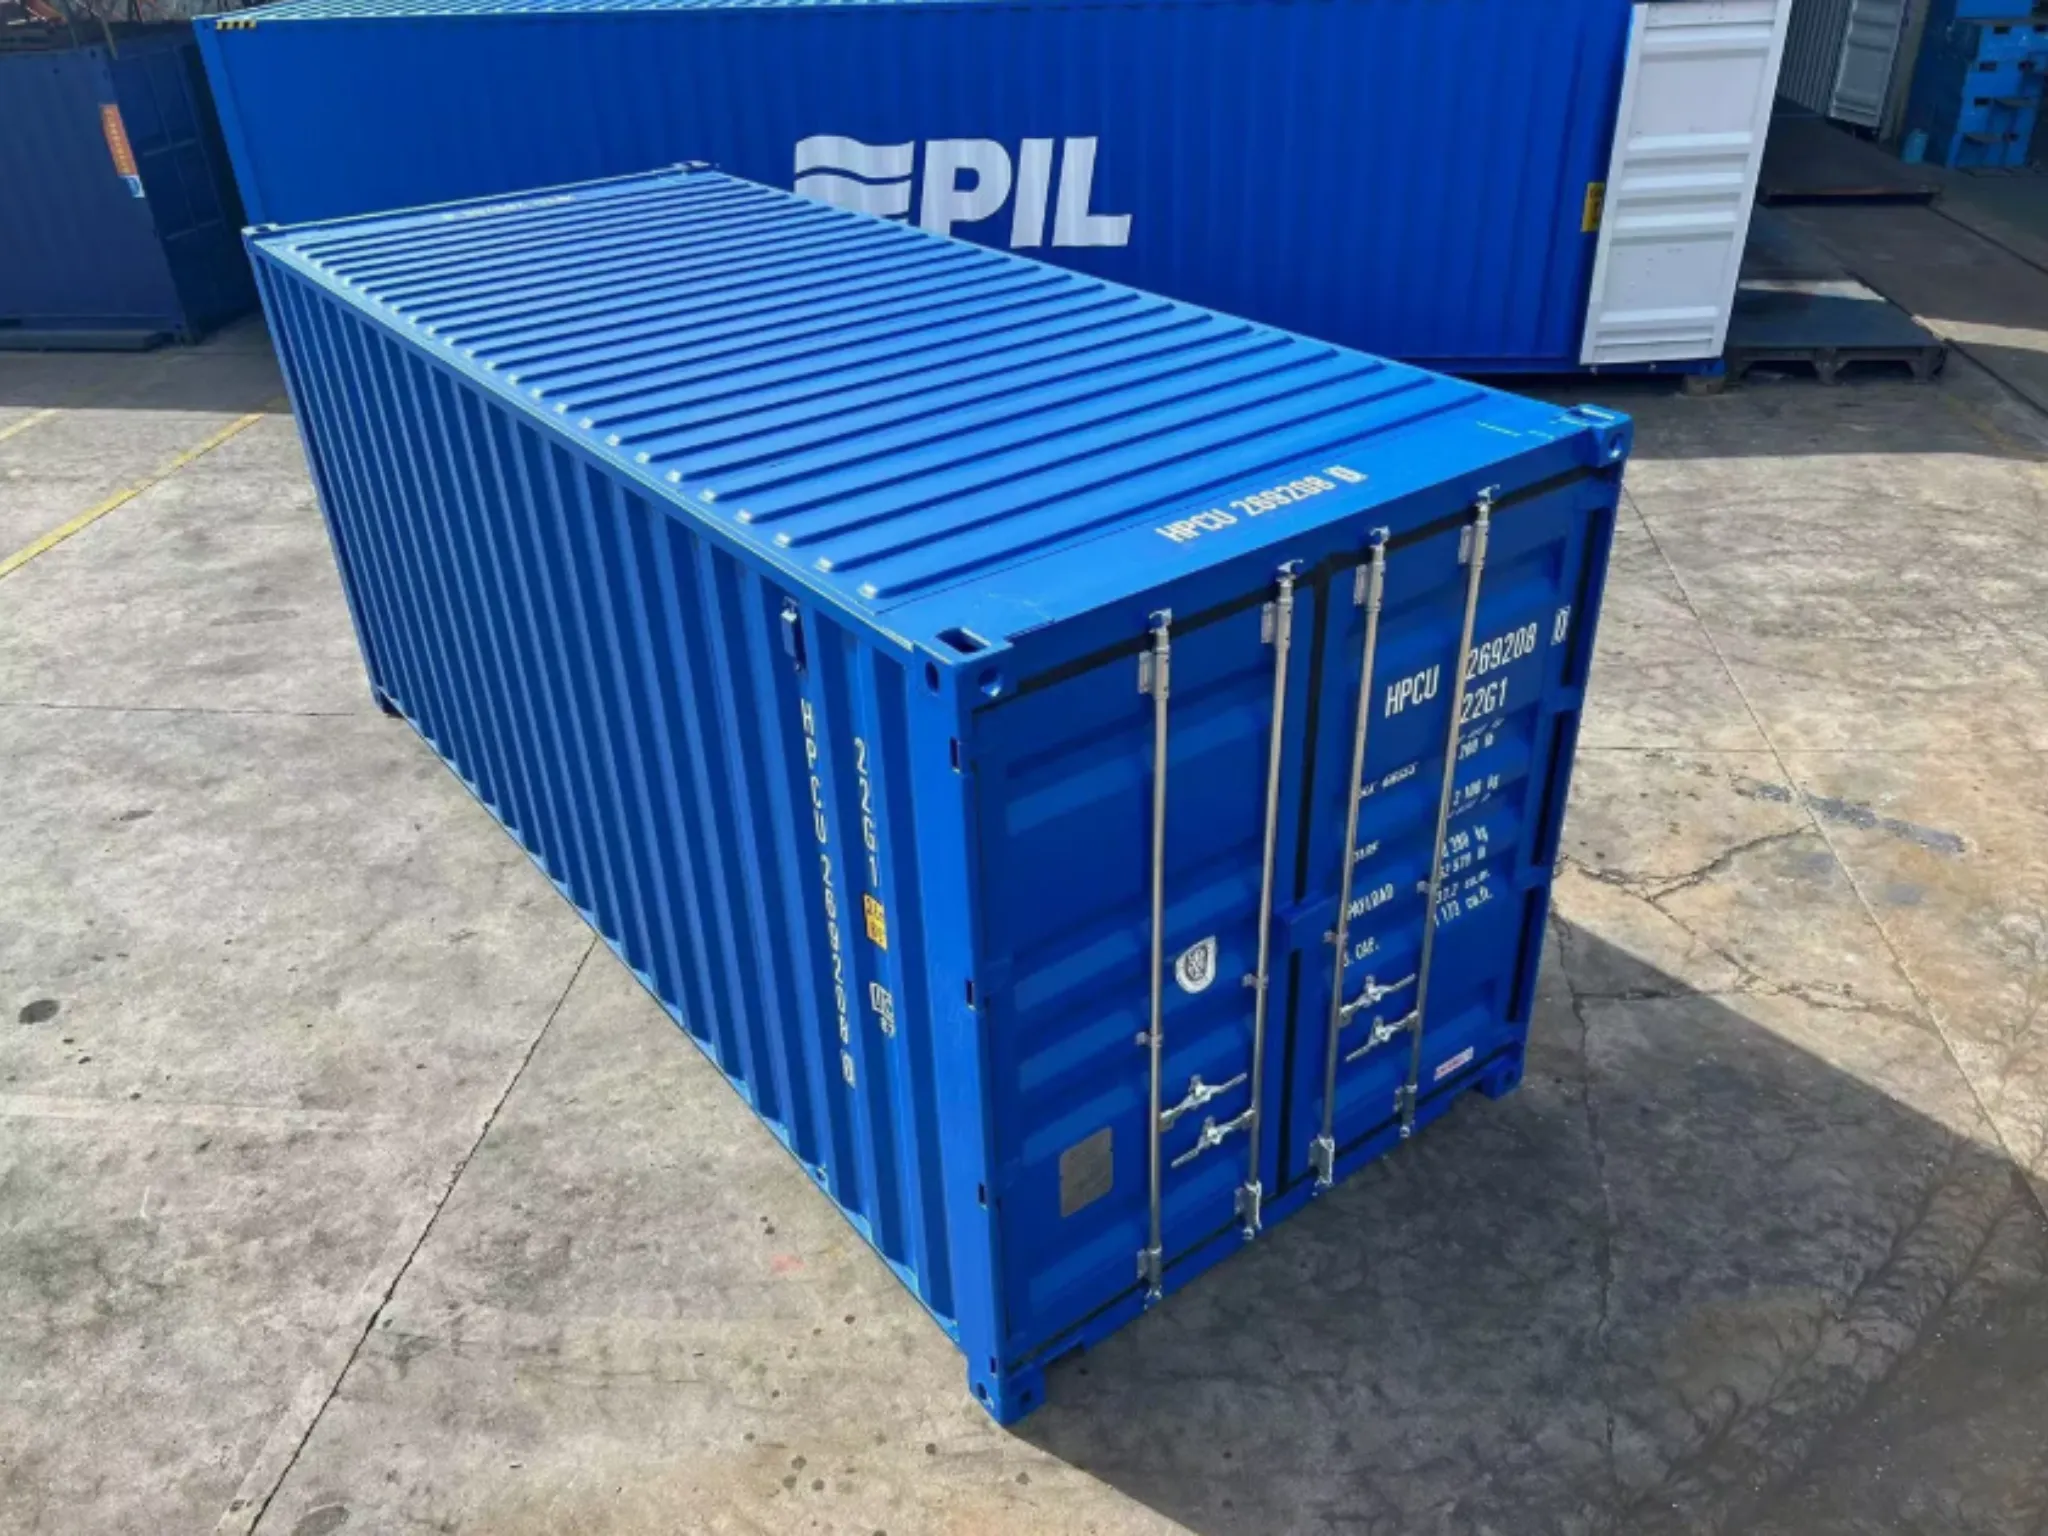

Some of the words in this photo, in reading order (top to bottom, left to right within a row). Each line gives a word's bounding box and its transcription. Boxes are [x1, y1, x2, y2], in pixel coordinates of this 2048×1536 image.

[920, 136, 1132, 248] PIL
[1155, 508, 1238, 543] HPCU
[1384, 664, 1440, 718] HPCU
[1464, 622, 1538, 680] 269208
[1459, 677, 1508, 724] 22G1
[801, 698, 828, 844] HPCU
